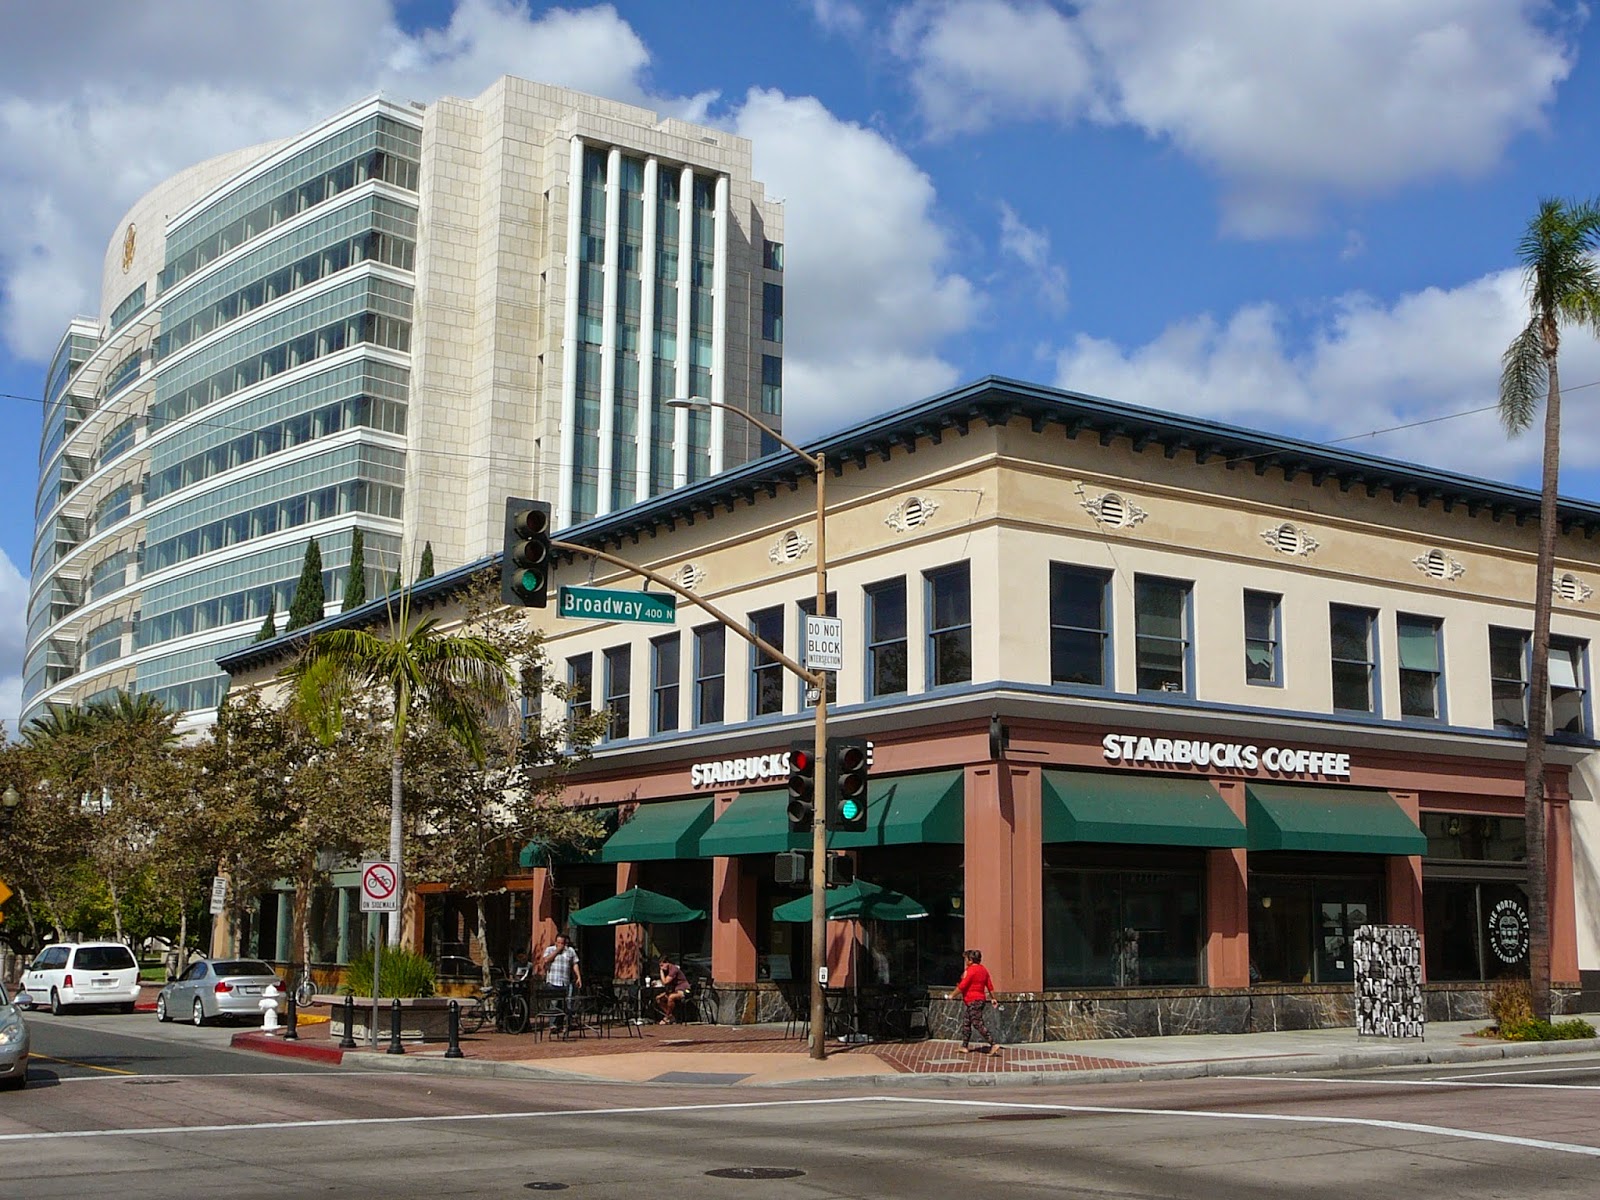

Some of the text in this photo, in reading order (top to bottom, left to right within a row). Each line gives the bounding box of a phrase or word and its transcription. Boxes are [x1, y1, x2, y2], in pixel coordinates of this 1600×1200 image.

[565, 594, 672, 619] Broadway 400 N
[809, 623, 840, 637] DO NOT
[809, 640, 840, 653] BLOCK
[808, 654, 840, 665] INTERSECTION
[1103, 734, 1350, 776] STARBUCKS COFFEE
[691, 751, 791, 786] STARBUCKS
[363, 901, 395, 909] ON SIDEWALK
[1488, 900, 1530, 929] THE NORTH LEFT
[1490, 937, 1519, 963] RESTAURANT
